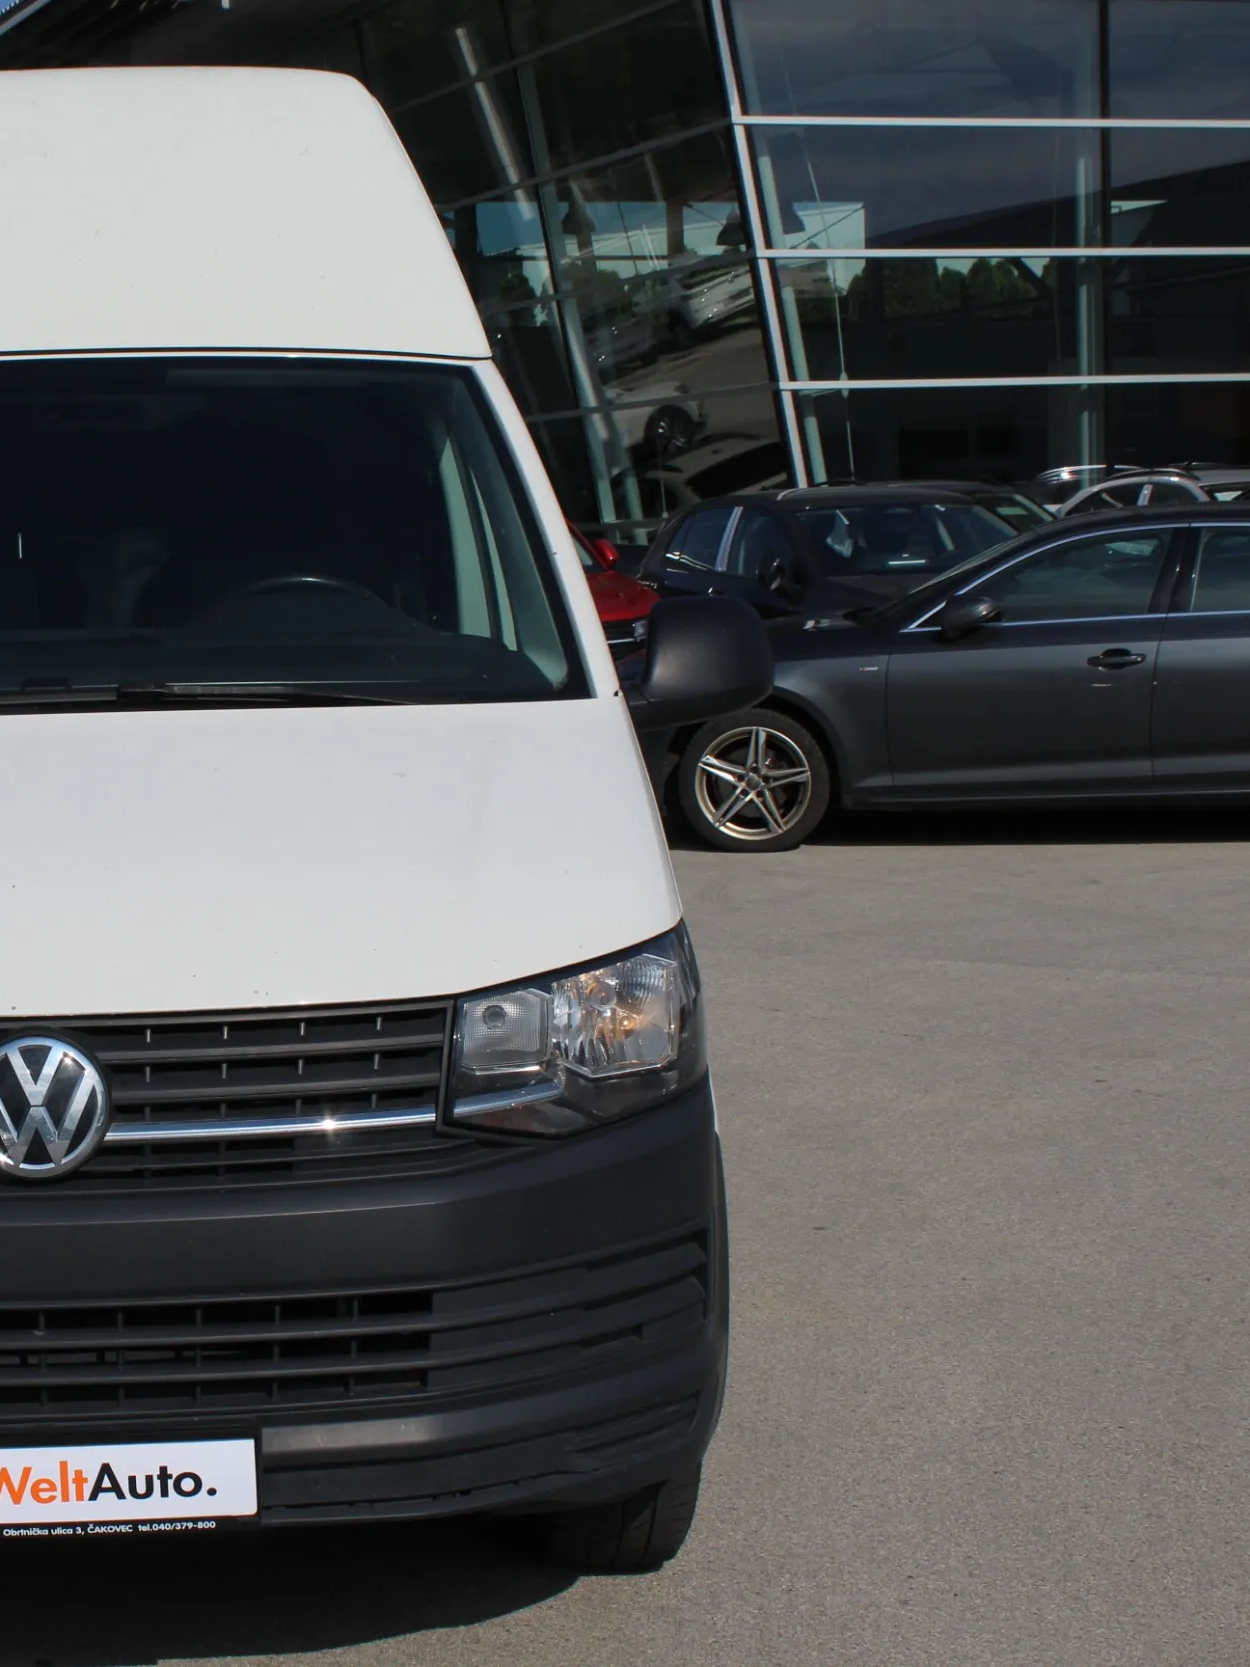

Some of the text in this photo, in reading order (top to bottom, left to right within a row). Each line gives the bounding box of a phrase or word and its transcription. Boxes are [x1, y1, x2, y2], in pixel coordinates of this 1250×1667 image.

[2, 1527, 49, 1537] Obrtnička
[51, 1525, 73, 1536] ulica
[75, 1526, 85, 1536] 3,
[87, 1524, 134, 1535] ČAKOVEC
[138, 1521, 217, 1532] tel.040/379-800
